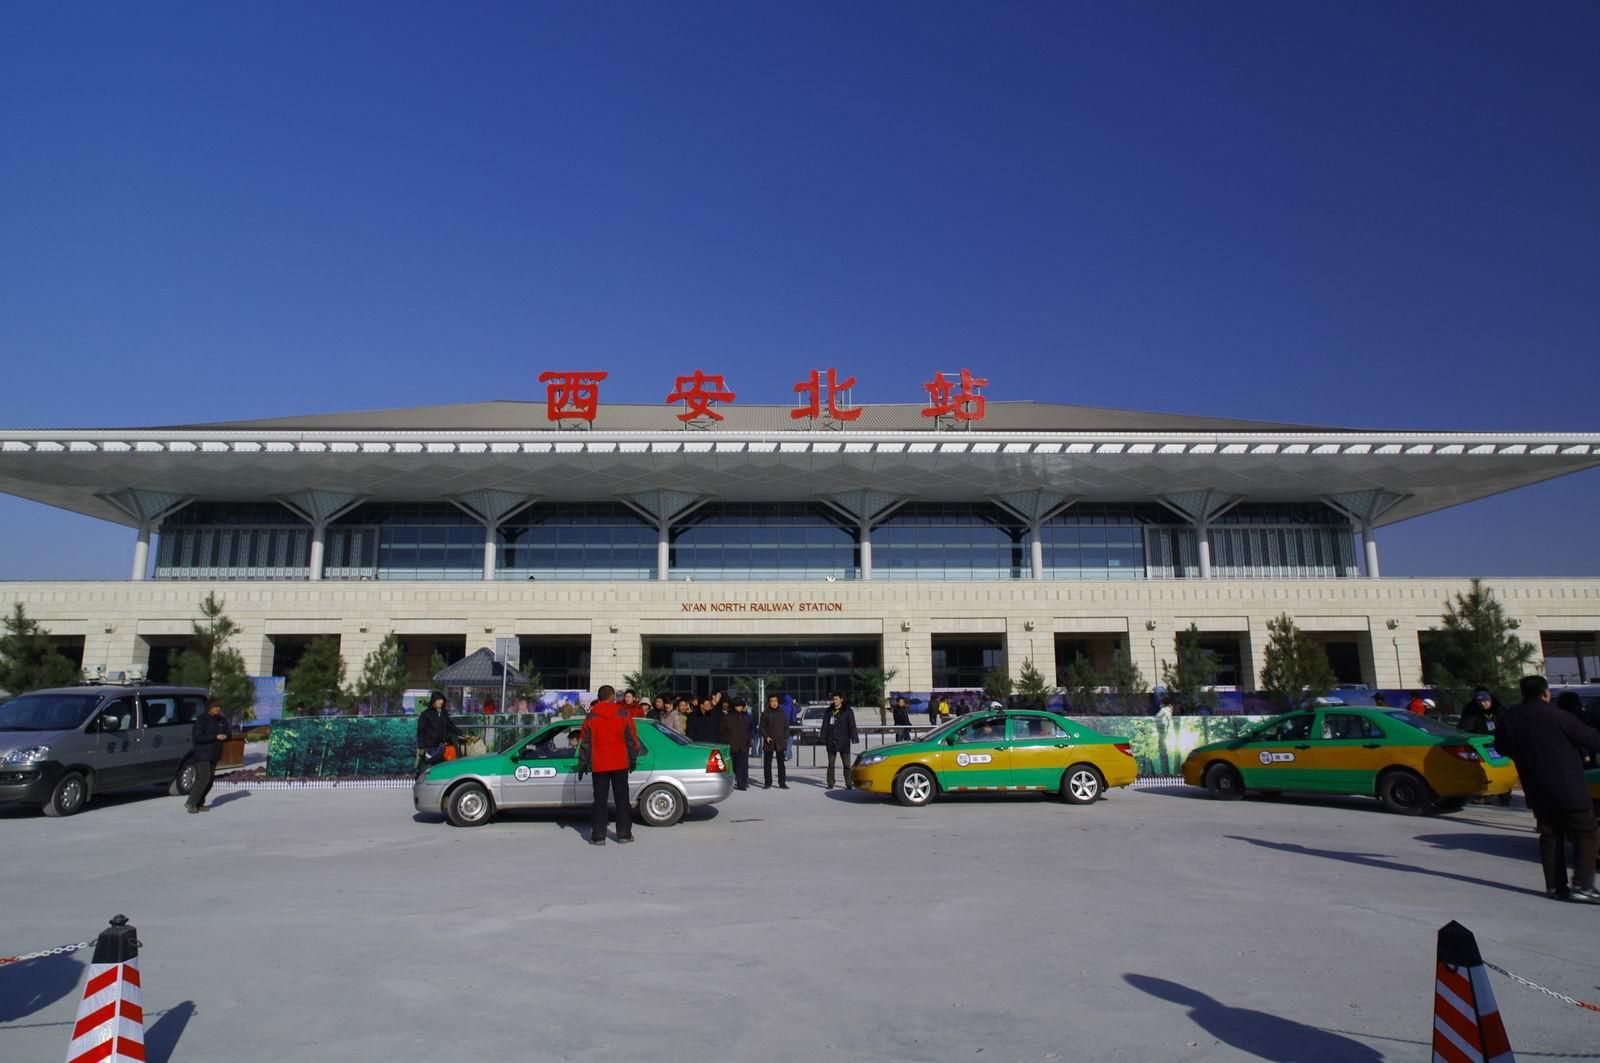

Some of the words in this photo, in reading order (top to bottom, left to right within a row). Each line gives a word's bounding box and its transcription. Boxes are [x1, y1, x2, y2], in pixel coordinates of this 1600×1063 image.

[539, 368, 988, 422] 西安北站
[681, 602, 707, 612] XI'AN
[710, 602, 746, 612] NORTH
[750, 602, 795, 612] RAILWAY
[798, 602, 843, 612] STATION
